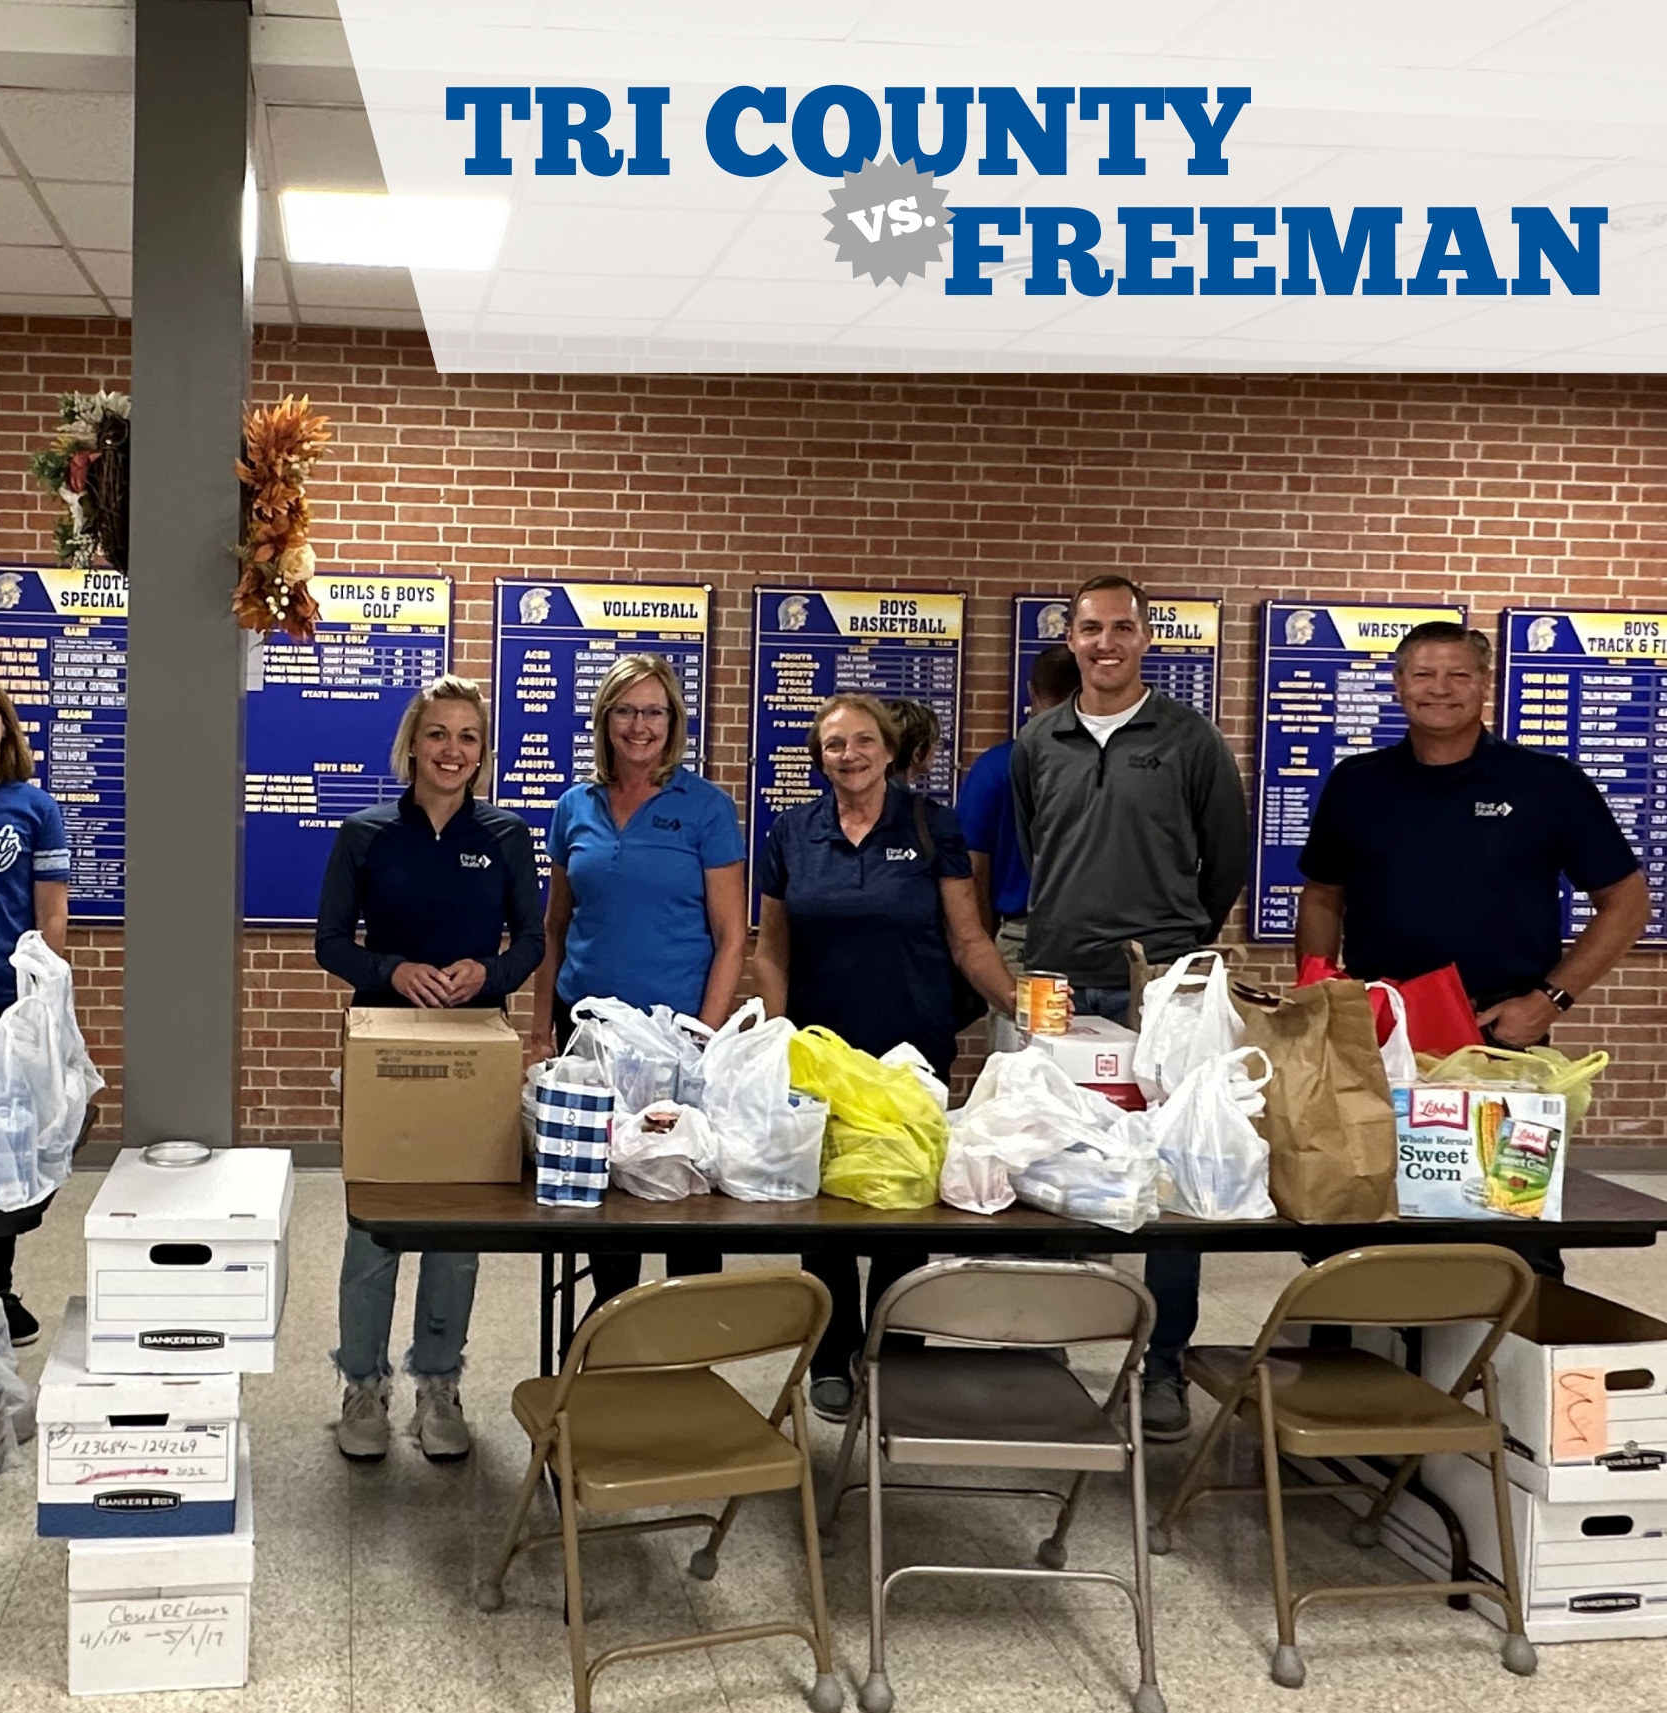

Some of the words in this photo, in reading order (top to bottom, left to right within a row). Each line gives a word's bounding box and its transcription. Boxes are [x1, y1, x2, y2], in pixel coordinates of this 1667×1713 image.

[60, 591, 125, 608] SPECIAL
[330, 584, 375, 600] GIRLS
[381, 585, 391, 601] &
[396, 586, 435, 602] BOYS
[362, 603, 402, 619] GOLF
[603, 601, 699, 619] VOLLEYBALL
[879, 599, 918, 616] BOYS
[849, 616, 947, 634] BASKETBALL
[1624, 621, 1659, 637] BOYS
[1587, 637, 1635, 653] TRACK
[1638, 638, 1648, 653] &
[1419, 1099, 1459, 1118] Libby's
[1398, 1134, 1433, 1145] Whole
[1436, 1136, 1473, 1146] Kernel
[1399, 1144, 1470, 1164] Sweet
[1405, 1163, 1462, 1181] Corn
[143, 1336, 195, 1345] BANKERS
[196, 1336, 220, 1345] BOX
[98, 1497, 149, 1506] BANKERS
[151, 1497, 174, 1506] BOX
